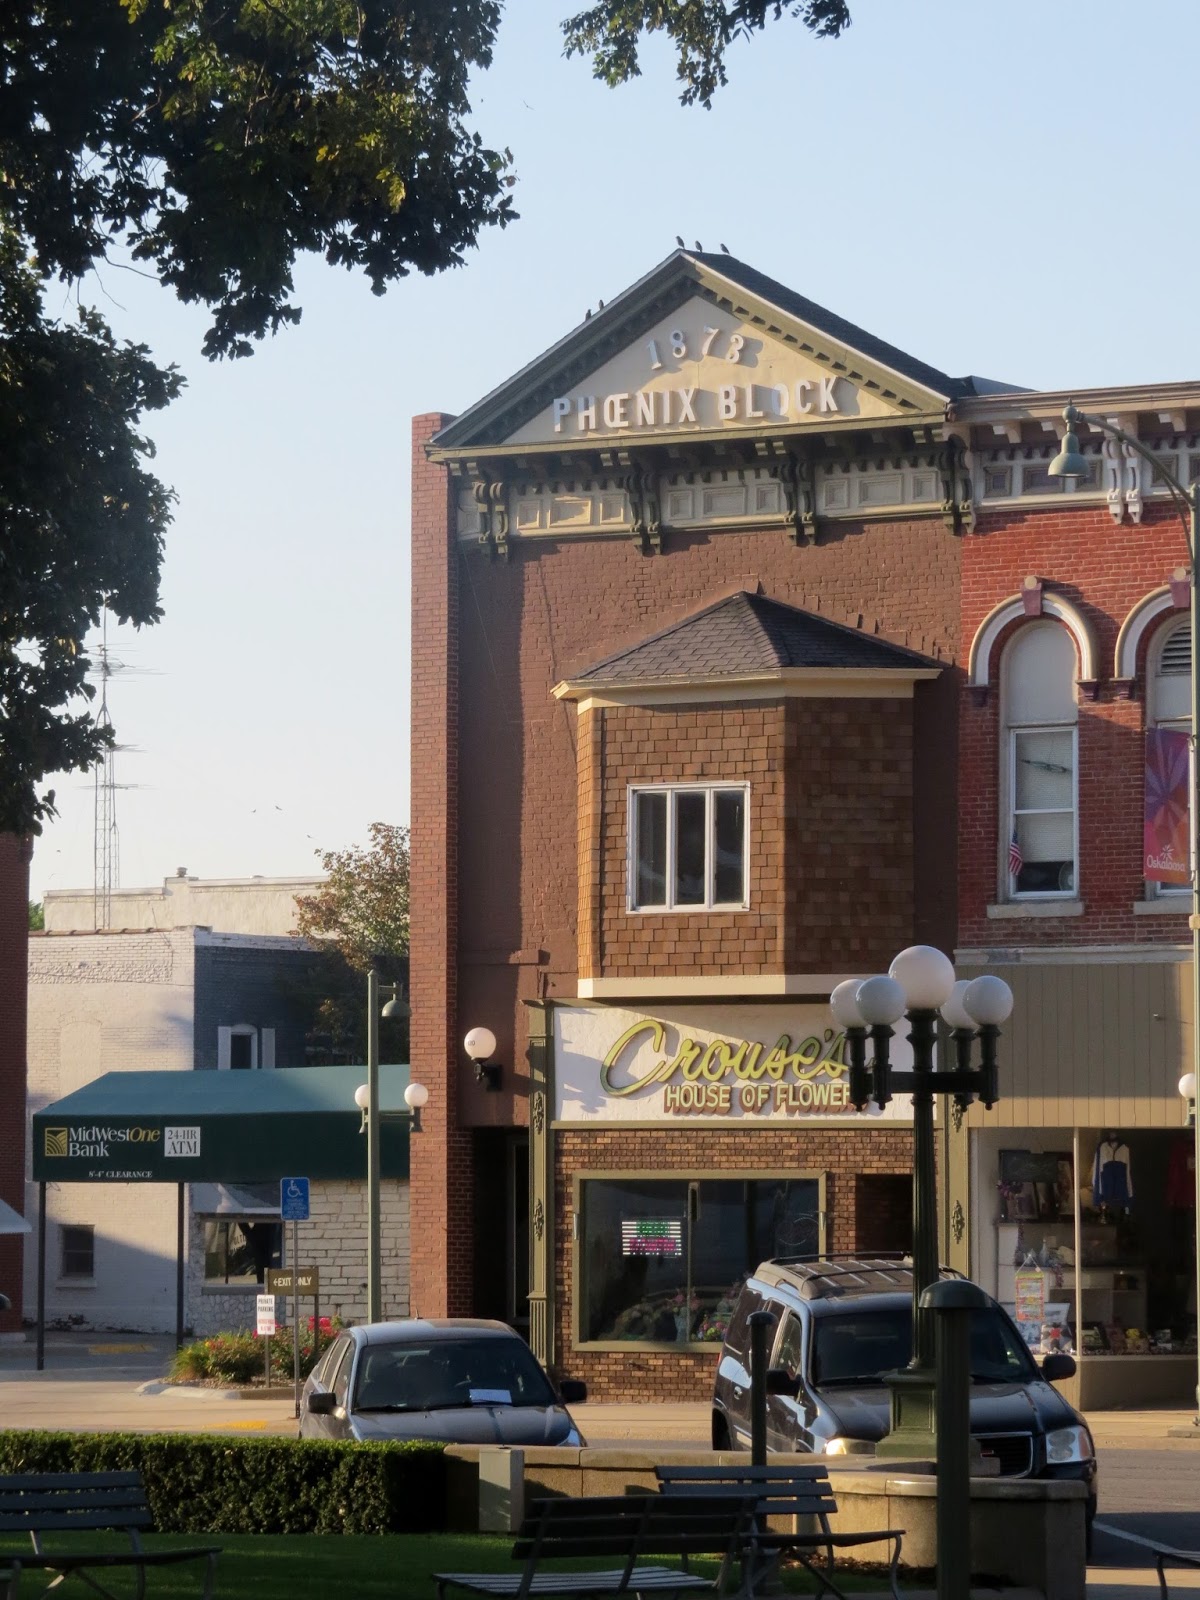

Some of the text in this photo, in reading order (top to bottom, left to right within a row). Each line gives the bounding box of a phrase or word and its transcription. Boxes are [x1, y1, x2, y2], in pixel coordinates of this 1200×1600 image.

[648, 325, 744, 370] 1873
[718, 376, 839, 420] BLOCK
[1146, 854, 1186, 872] Oskaloosa
[599, 1019, 850, 1097] Crouse's
[666, 1084, 731, 1108] HOUSE
[741, 1083, 770, 1107] OF
[69, 1126, 161, 1143] MidWestOne
[167, 1129, 198, 1140] 24-HR
[69, 1141, 110, 1157] Bank
[167, 1140, 198, 1155] ATM
[105, 1170, 153, 1179] CLEARANCE
[277, 1276, 312, 1287] EXIT NLY
